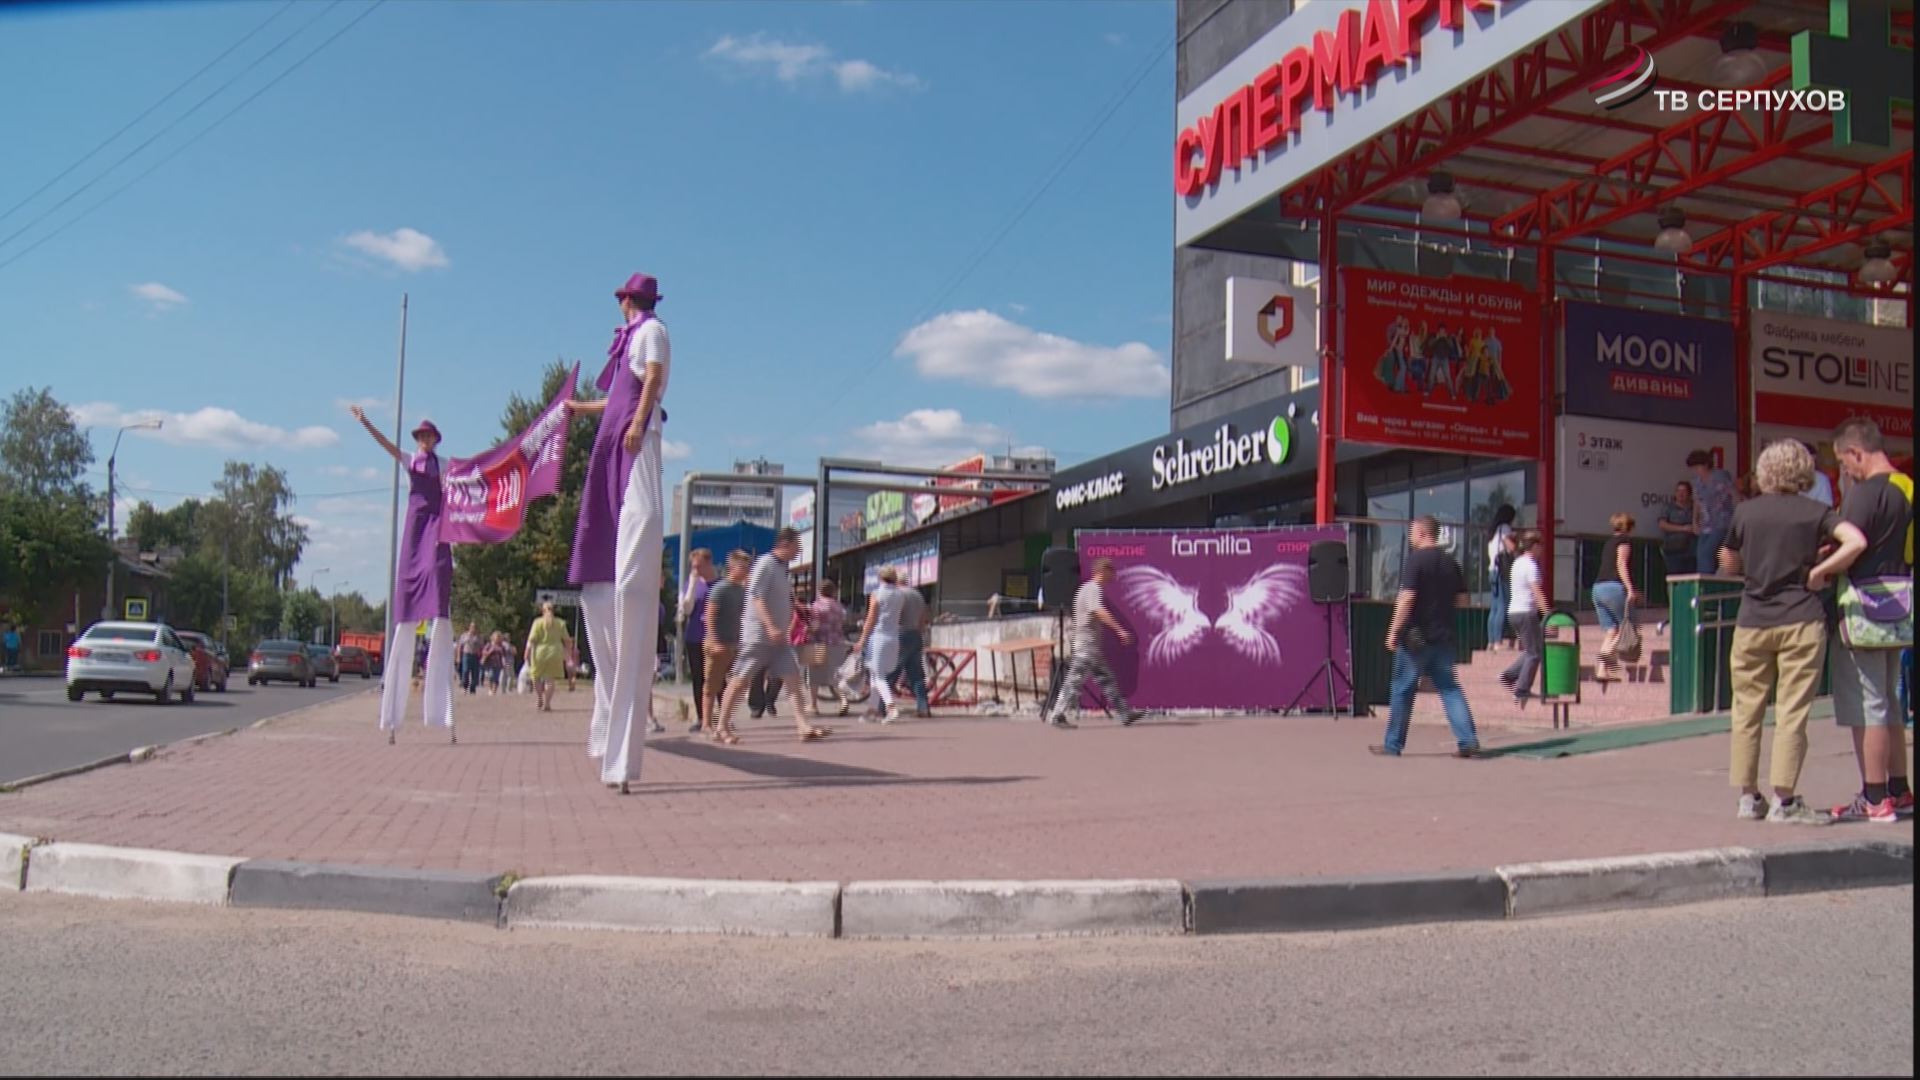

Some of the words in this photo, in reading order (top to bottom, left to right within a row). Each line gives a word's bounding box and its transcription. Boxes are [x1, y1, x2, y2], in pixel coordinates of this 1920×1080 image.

[1366, 278, 1396, 294] МИР
[1400, 282, 1462, 303] ОДЕЖДЫ
[1465, 293, 1474, 304] И
[1478, 294, 1523, 312] ОБУВИ
[1764, 323, 1818, 344] Фабрика
[1821, 332, 1865, 348] мебели
[1596, 330, 1696, 374] MOON
[1578, 432, 1587, 448] 3
[1590, 436, 1624, 451] этаж
[1152, 424, 1267, 491] Schreiber
[1056, 469, 1124, 511] ОФИС-КЛАСС
[1087, 544, 1147, 557] ОТКРЫТИЕ
[1171, 534, 1253, 557] familia
